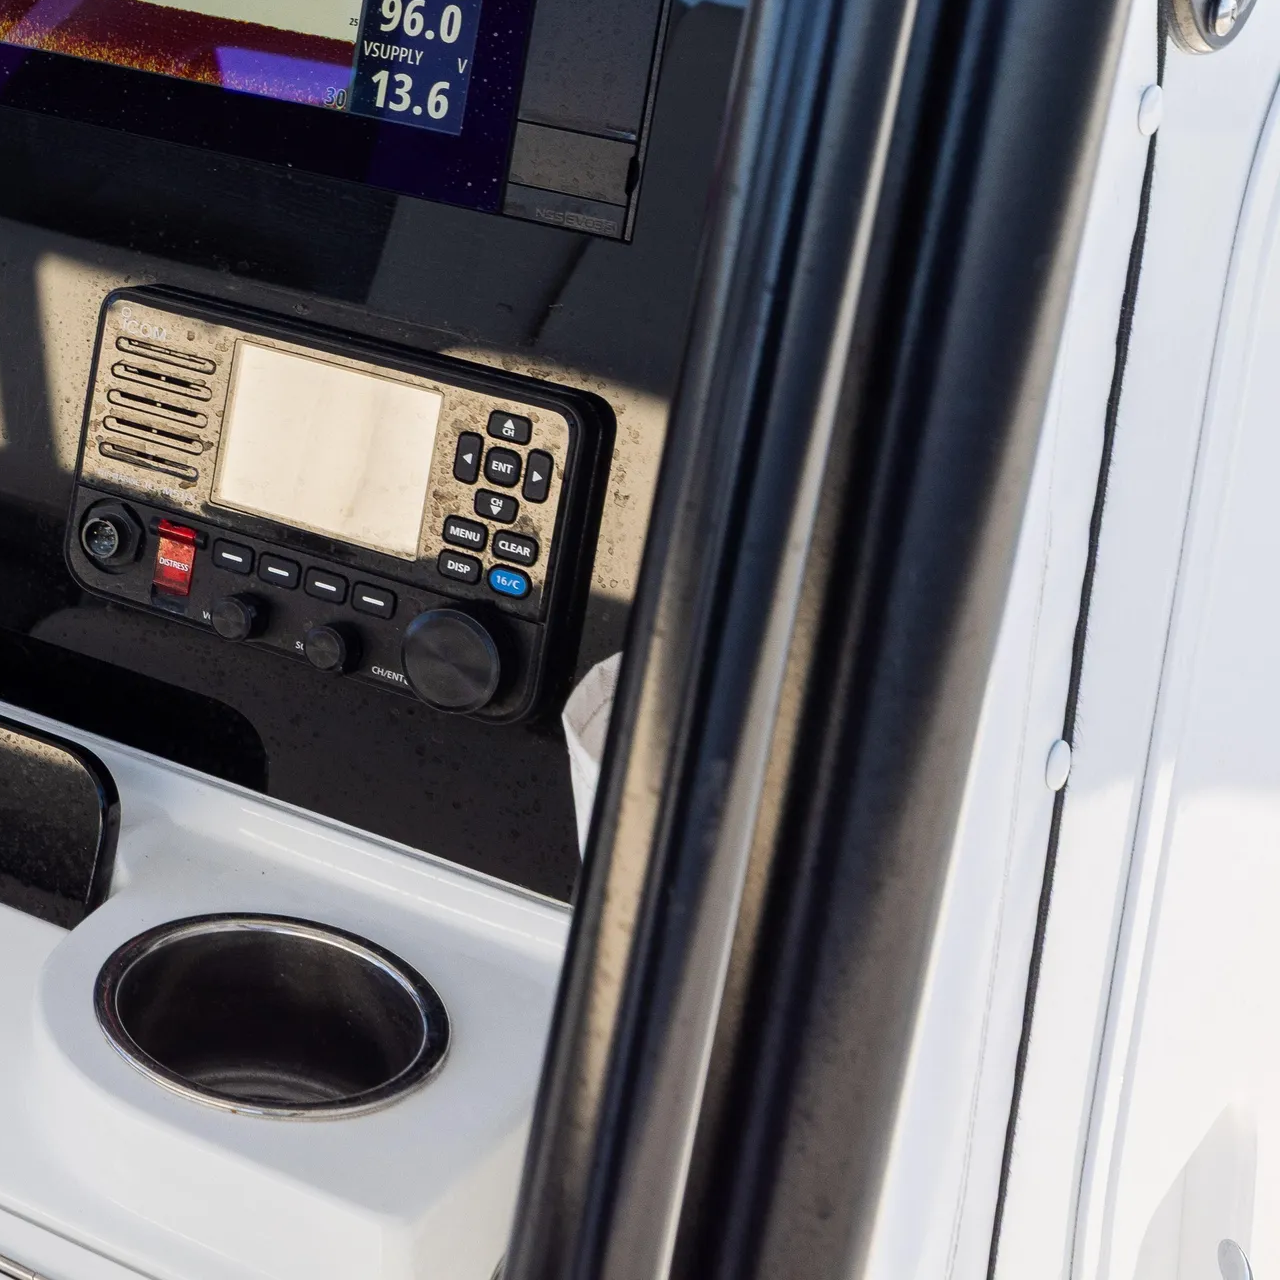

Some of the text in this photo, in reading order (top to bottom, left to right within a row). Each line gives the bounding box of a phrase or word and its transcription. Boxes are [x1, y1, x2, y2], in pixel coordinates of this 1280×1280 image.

[349, 17, 359, 28] 25
[363, 40, 424, 67] VSUPPLY
[457, 58, 468, 75] V
[325, 87, 347, 107] 30
[371, 69, 451, 120] 13.6
[502, 427, 515, 438] CH
[491, 460, 514, 475] ENT
[490, 497, 503, 508] CH
[449, 525, 481, 542] MENU
[498, 540, 531, 557] CLEAR
[159, 557, 189, 572] DISTRESS
[447, 560, 471, 574] DISP
[496, 574, 520, 590] 16/C
